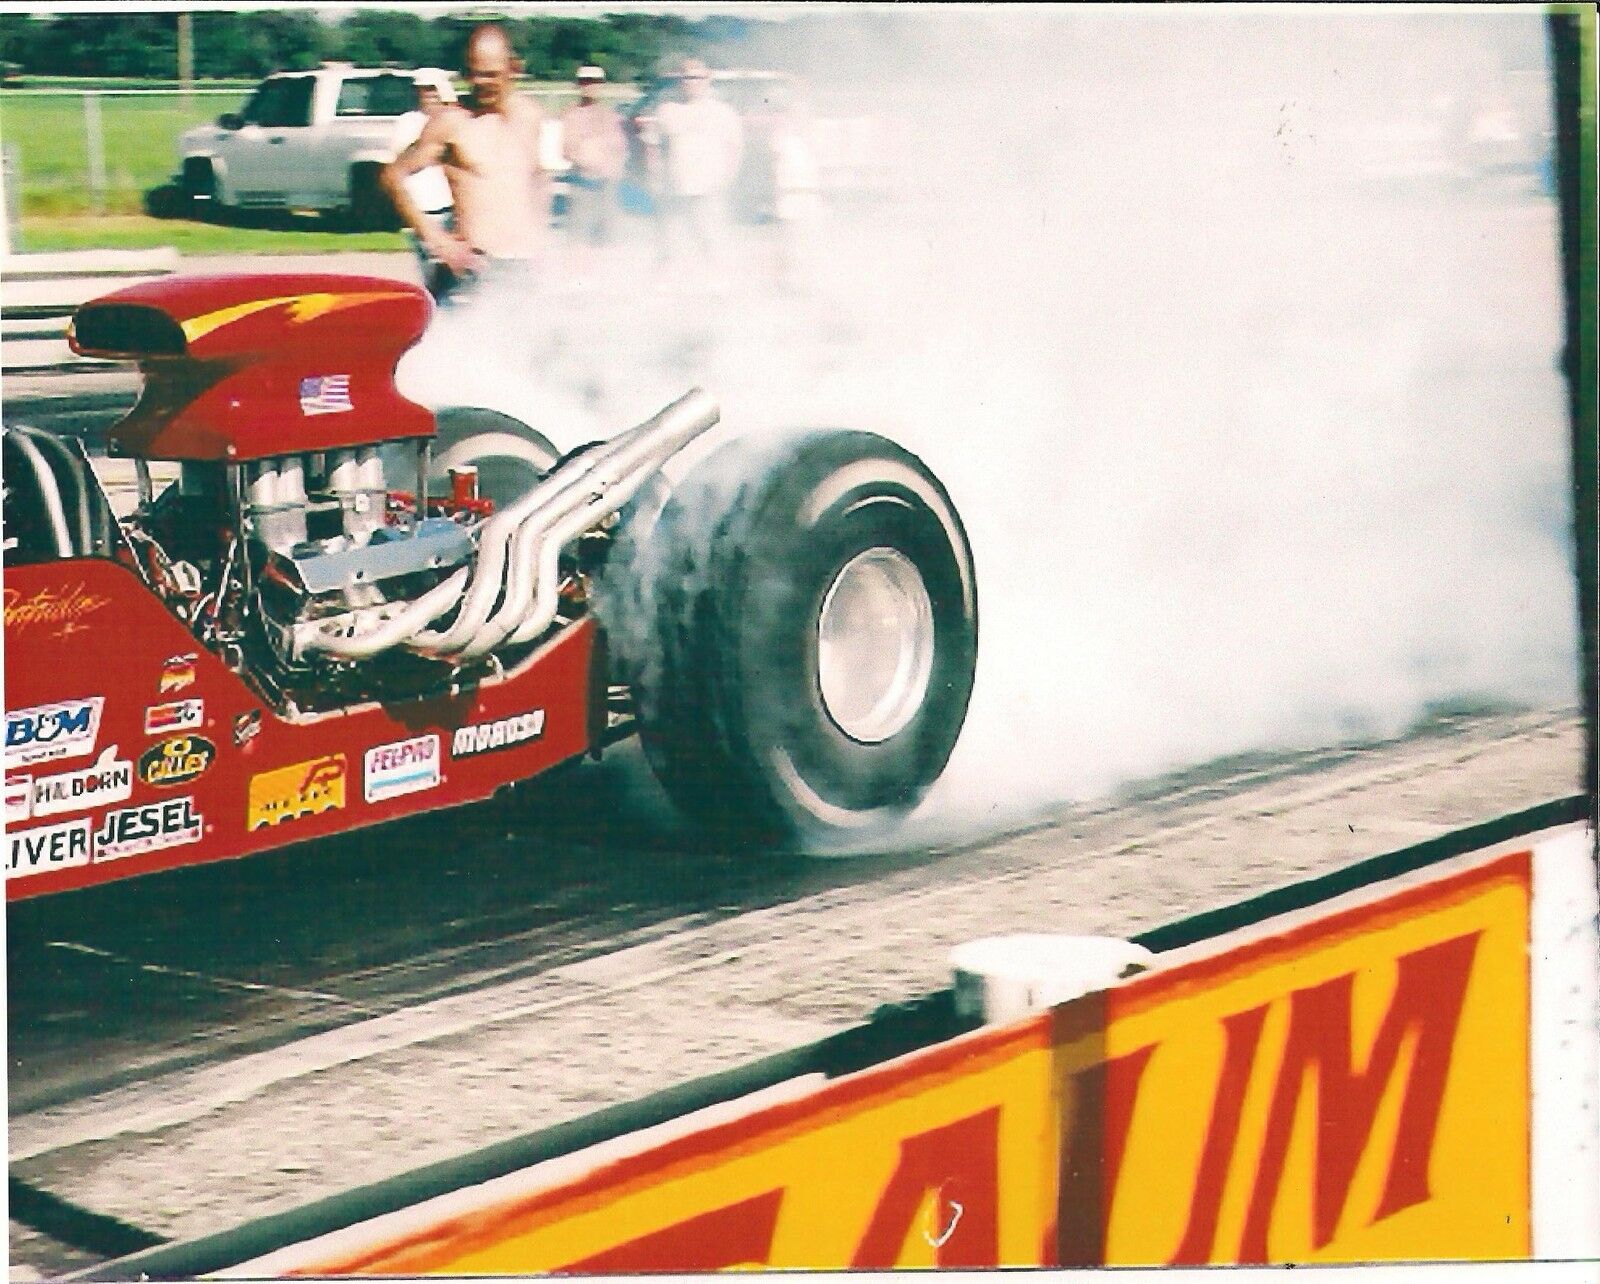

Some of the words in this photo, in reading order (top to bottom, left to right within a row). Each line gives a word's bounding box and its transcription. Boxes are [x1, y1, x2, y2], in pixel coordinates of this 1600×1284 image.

[5, 706, 93, 746] B&M
[97, 800, 201, 846] JESEL
[5, 827, 87, 870] IVER
